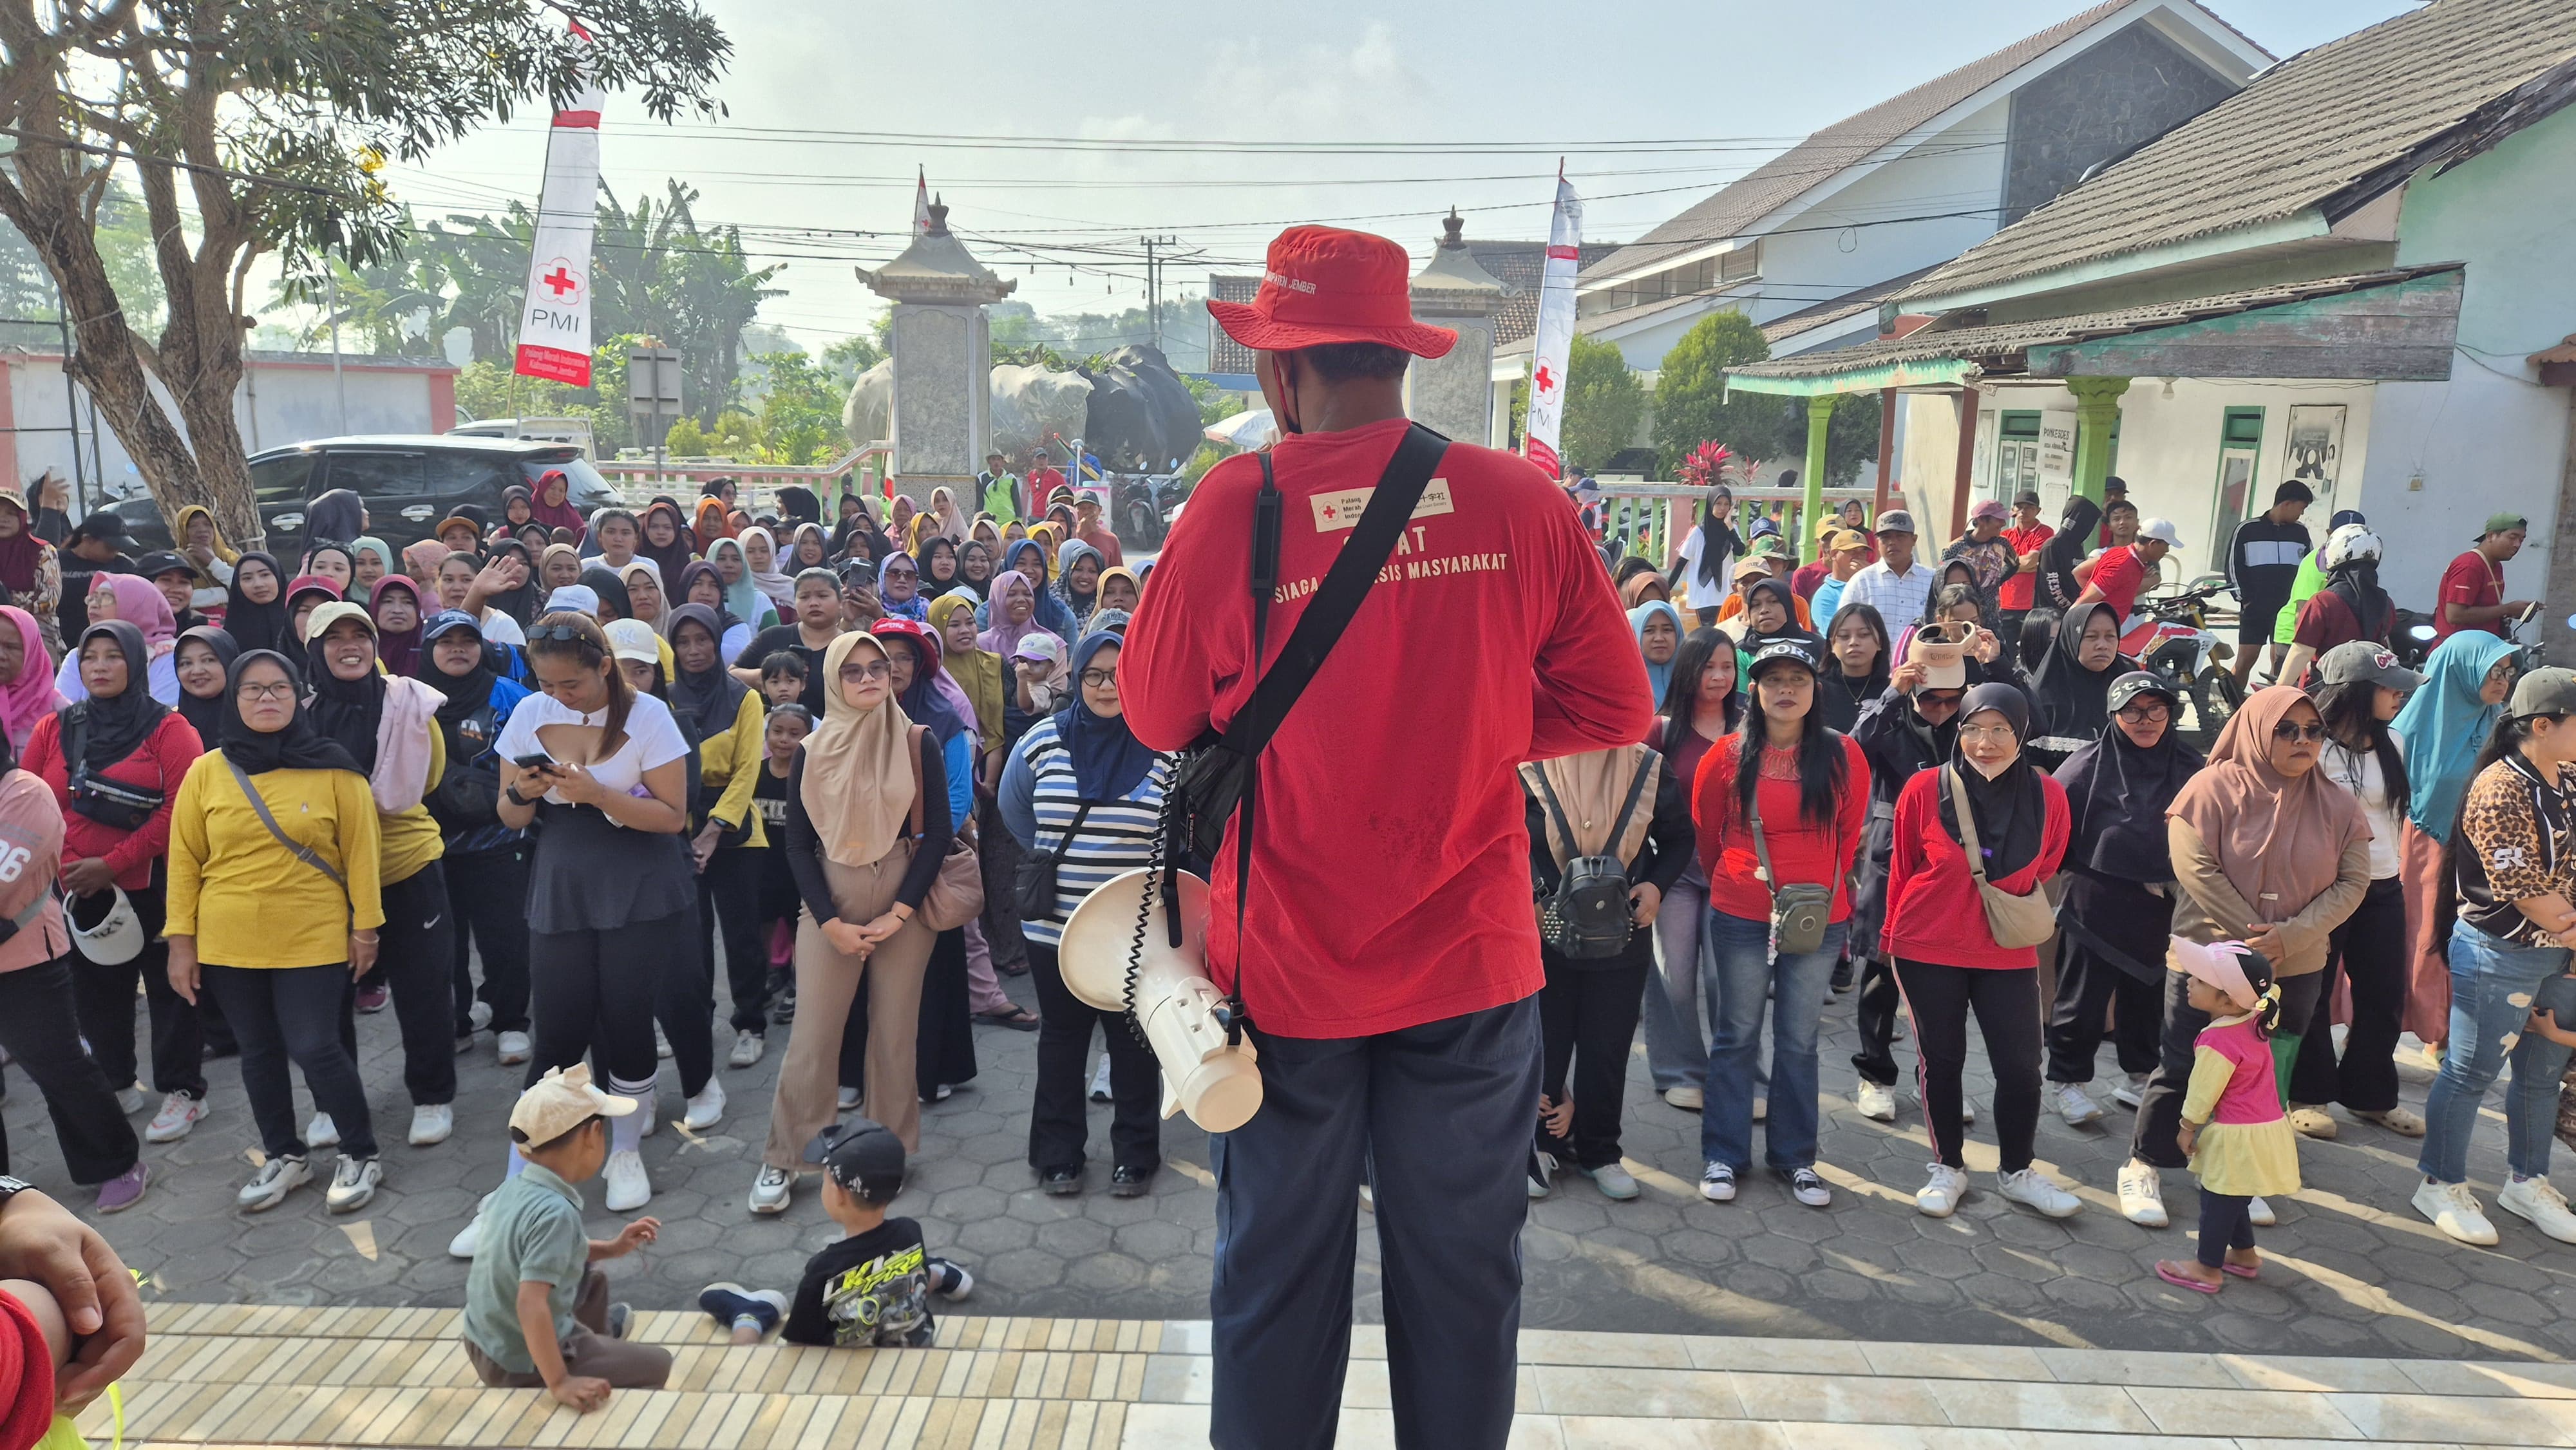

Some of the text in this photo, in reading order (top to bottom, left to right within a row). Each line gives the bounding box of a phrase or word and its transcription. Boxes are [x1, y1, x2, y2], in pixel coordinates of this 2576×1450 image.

[1289, 278, 1316, 294] JEMBER
[532, 309, 579, 333] PMI
[1274, 577, 1319, 604] SIAGA
[1407, 554, 1507, 579] MASYARAKAT
